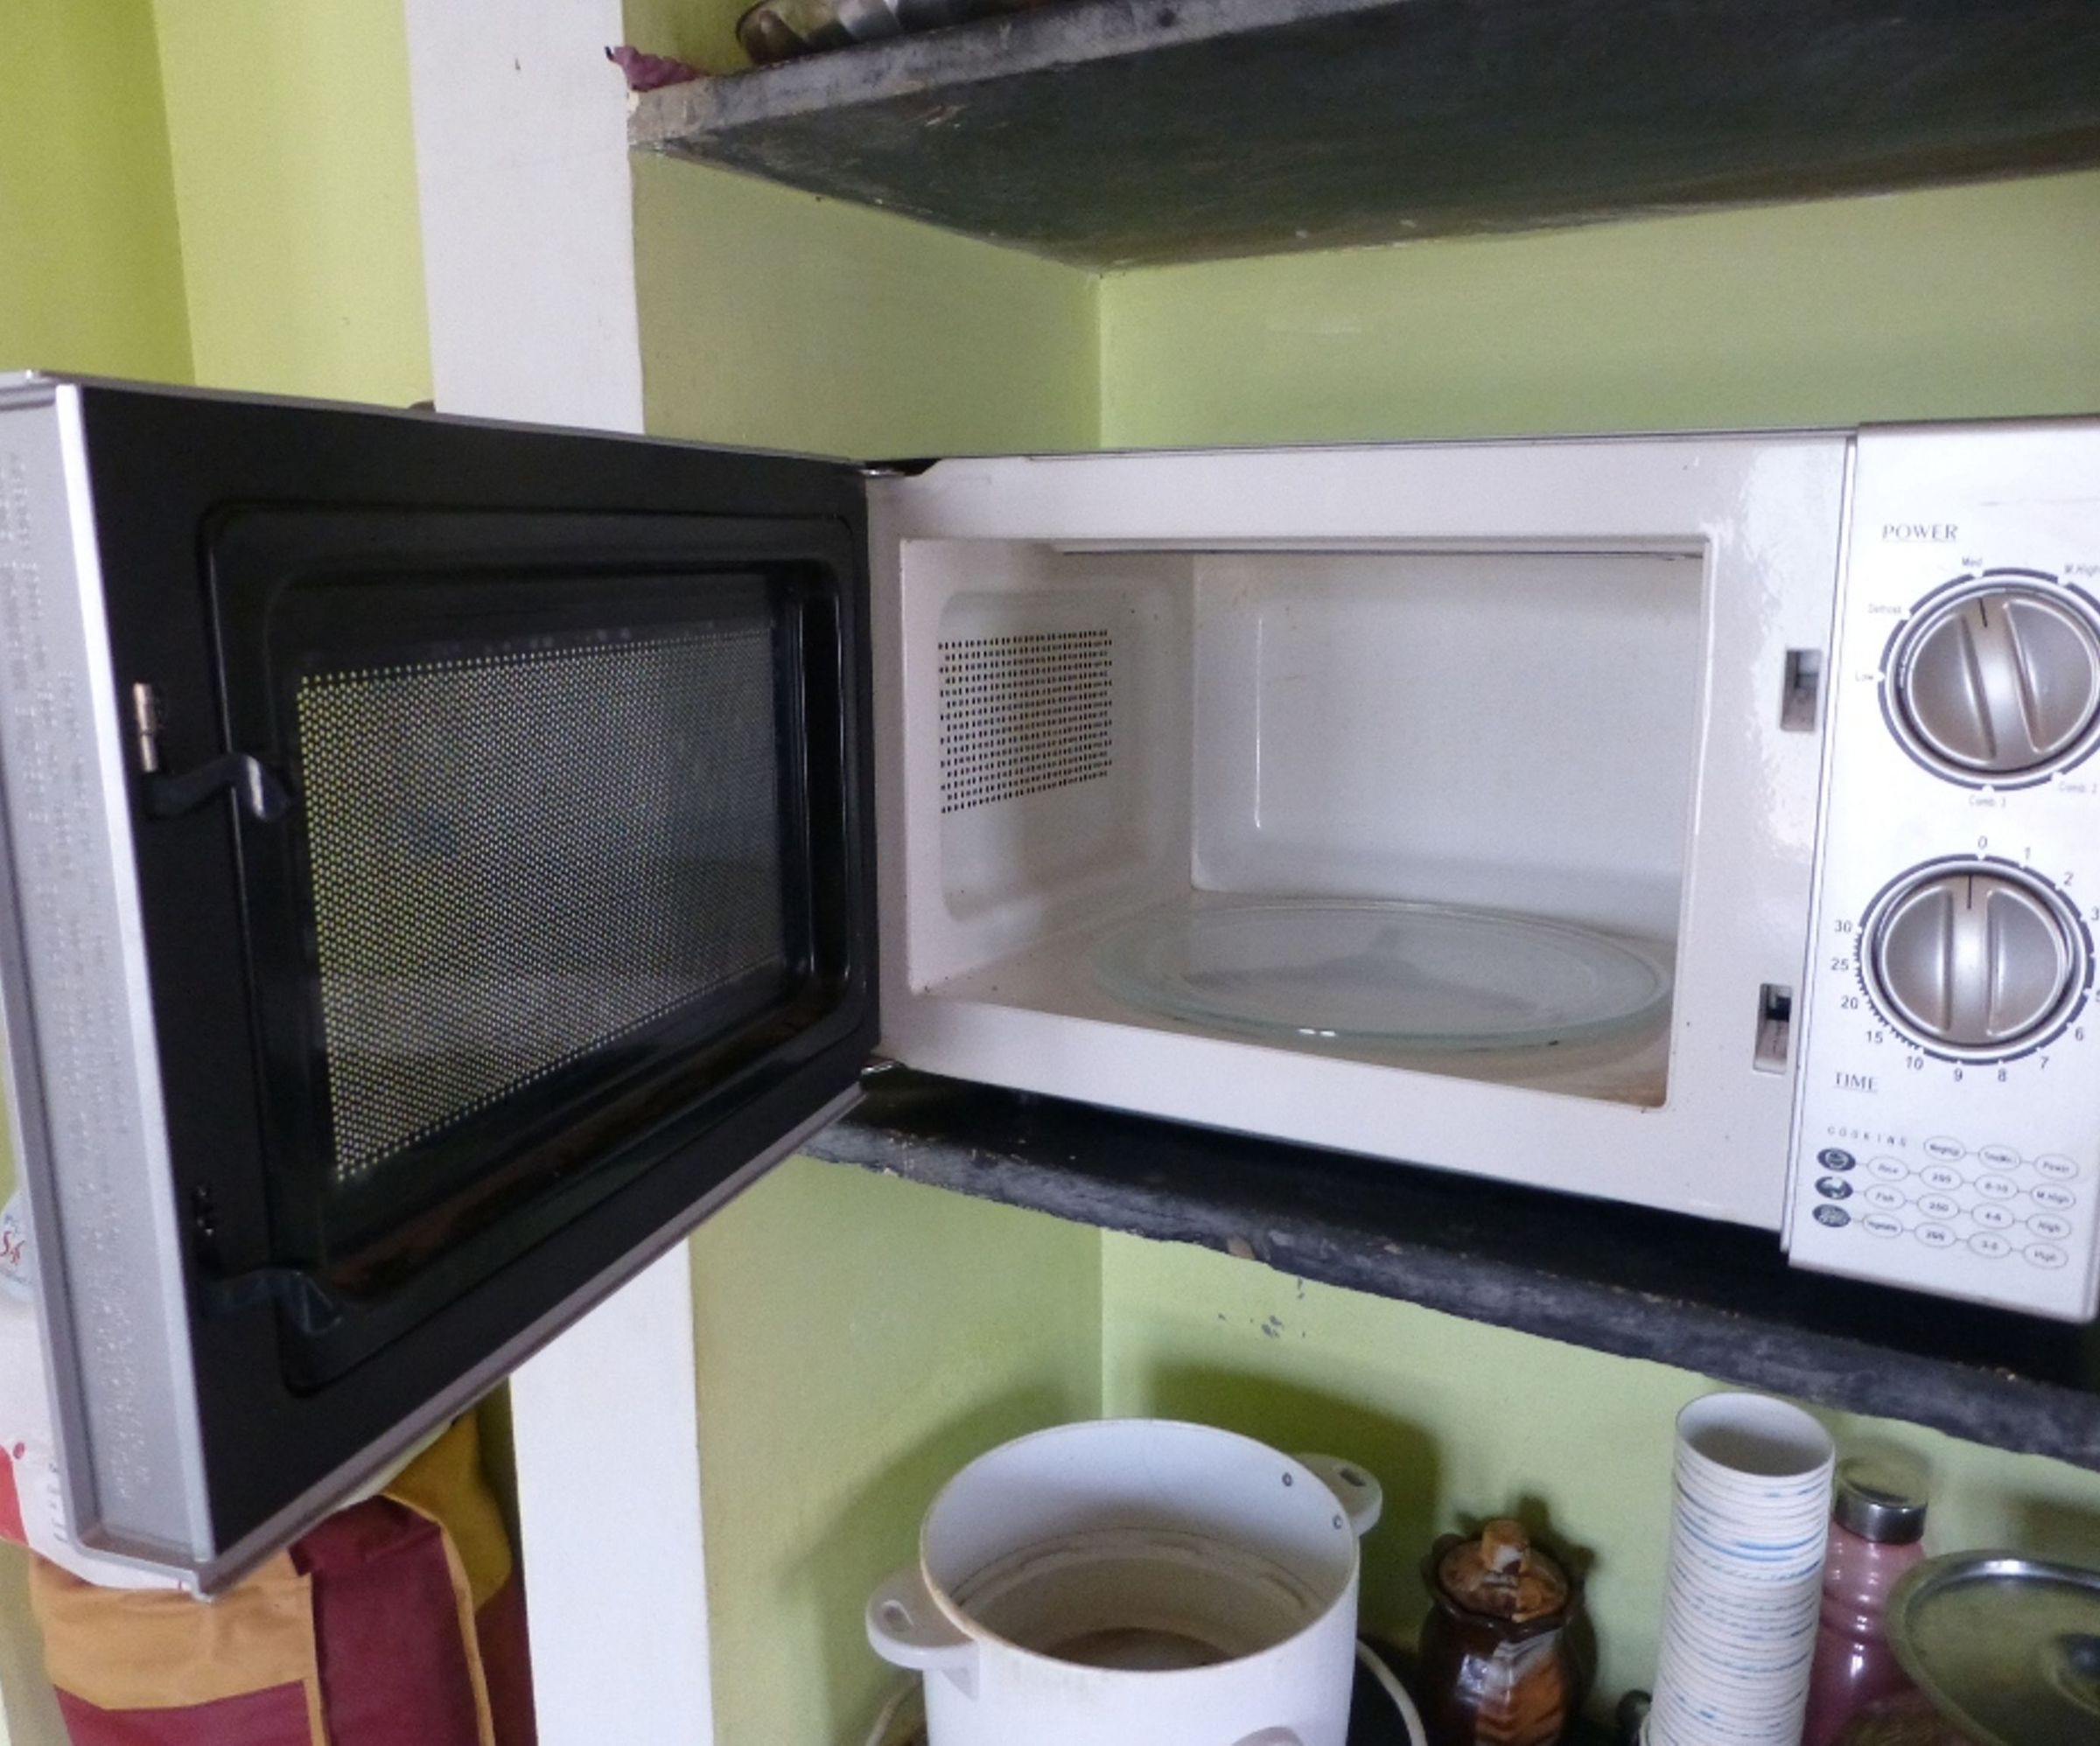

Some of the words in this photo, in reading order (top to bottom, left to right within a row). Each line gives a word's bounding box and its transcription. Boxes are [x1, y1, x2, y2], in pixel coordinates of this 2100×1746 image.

[1881, 524, 1958, 540] POWER
[1856, 674, 1874, 682] Low
[1978, 836, 1988, 849] 0
[2063, 872, 2074, 884] 2
[1834, 919, 1852, 932] 30
[1830, 958, 1849, 971] 25
[1841, 995, 1858, 1009] 20
[1866, 1030, 1883, 1043] 15
[2075, 1029, 2083, 1041] 6
[1906, 1056, 1923, 1070] 10
[2040, 1057, 2049, 1069] 7
[1835, 1072, 1879, 1091] TIME
[1954, 1069, 1964, 1082] 9
[1998, 1069, 2007, 1082] 8
